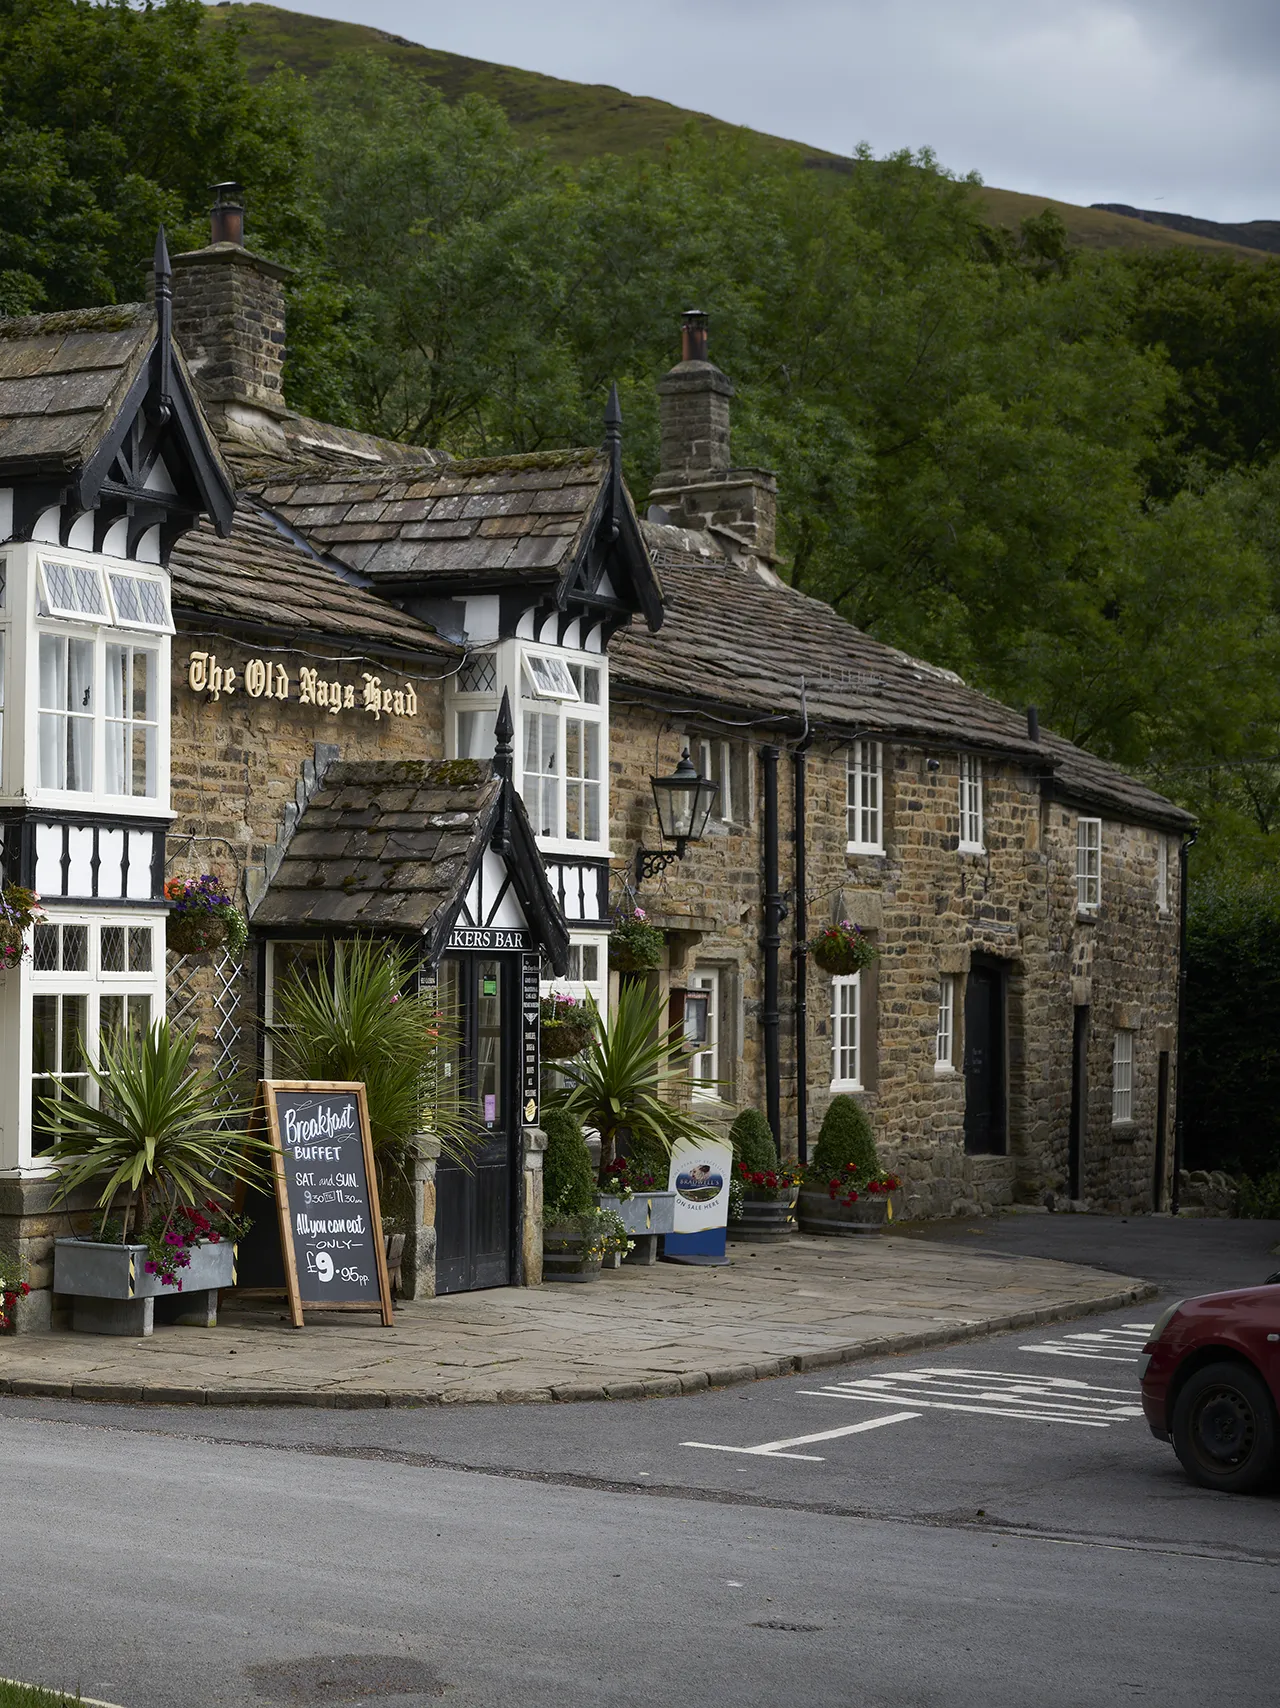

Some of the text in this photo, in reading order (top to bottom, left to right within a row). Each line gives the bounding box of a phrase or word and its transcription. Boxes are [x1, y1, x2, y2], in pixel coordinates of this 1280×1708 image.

[188, 651, 418, 721] The Old Nags Head
[448, 930, 523, 948] IKERS BAR
[284, 1104, 355, 1144] Breakfast
[294, 1146, 342, 1160] BUFFET
[296, 1172, 360, 1188] SAT. and SUN.
[676, 1198, 686, 1207] ON
[704, 1200, 720, 1210] HERE
[296, 1213, 366, 1238] All you can eat
[316, 1240, 352, 1250] ONLY
